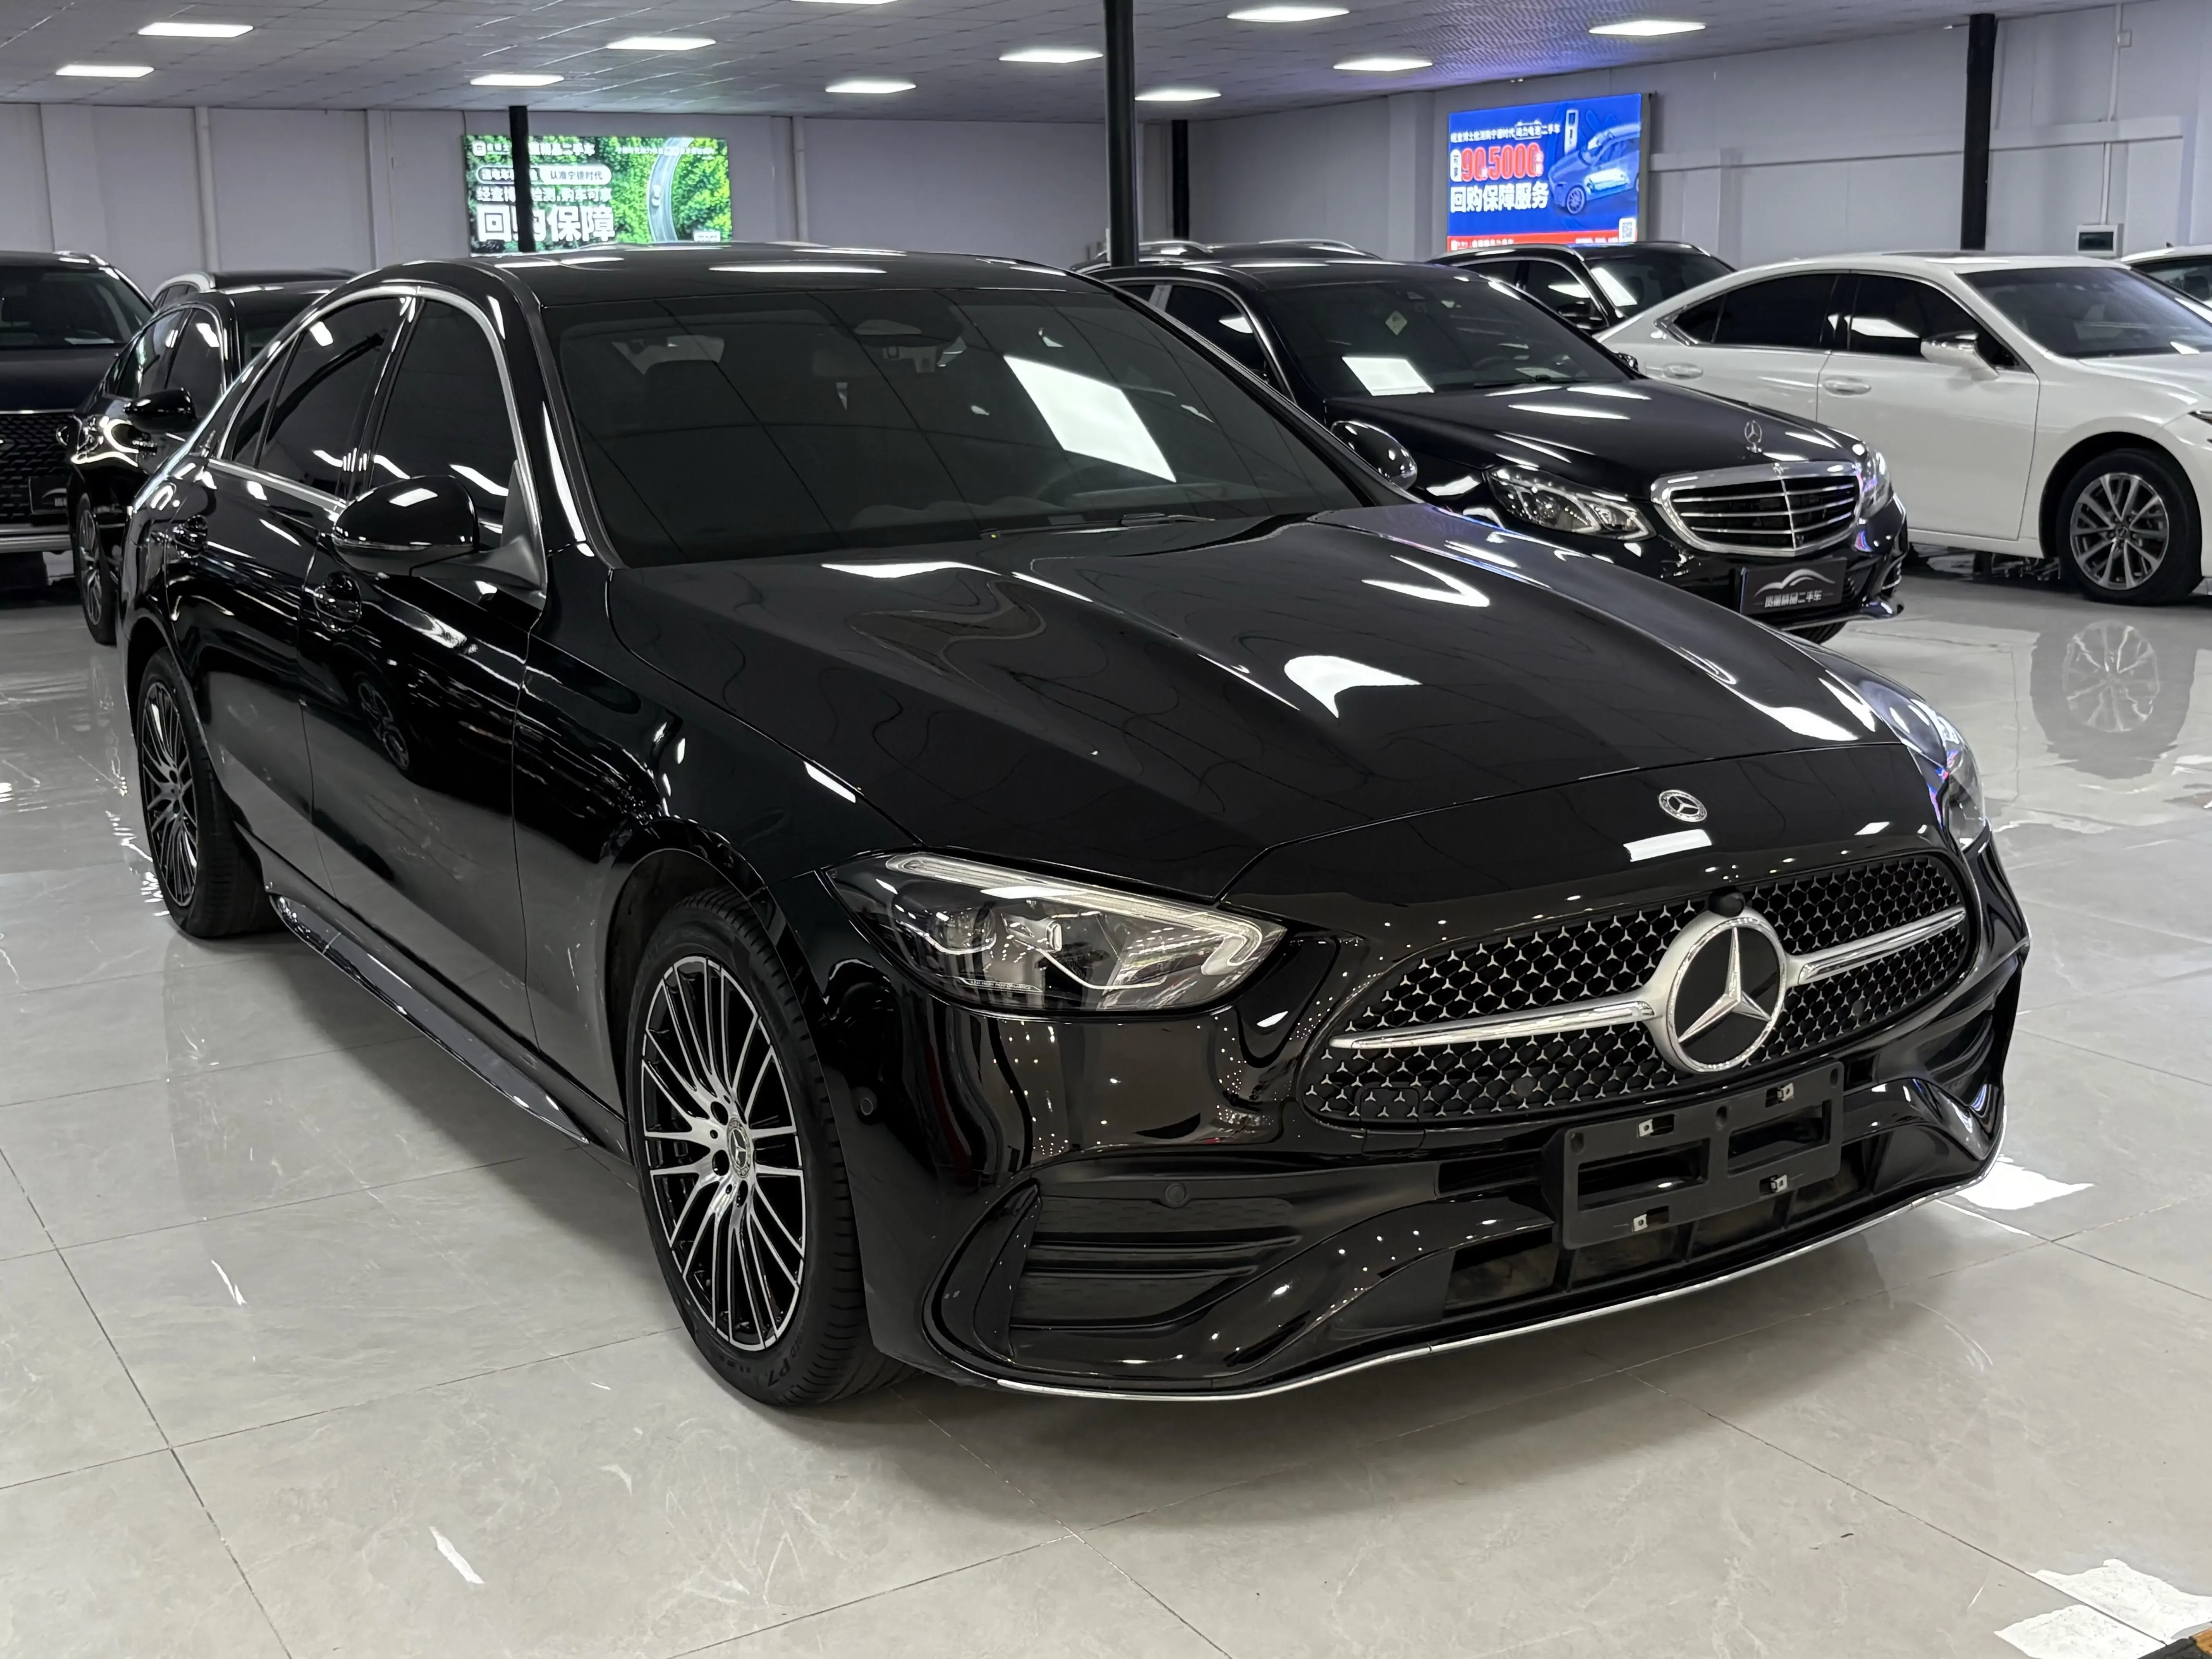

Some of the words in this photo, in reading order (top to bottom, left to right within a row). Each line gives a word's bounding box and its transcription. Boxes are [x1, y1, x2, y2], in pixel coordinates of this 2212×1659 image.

[550, 171, 603, 180] 认准宁德时代
[1450, 180, 1549, 213] 回购保障服务
